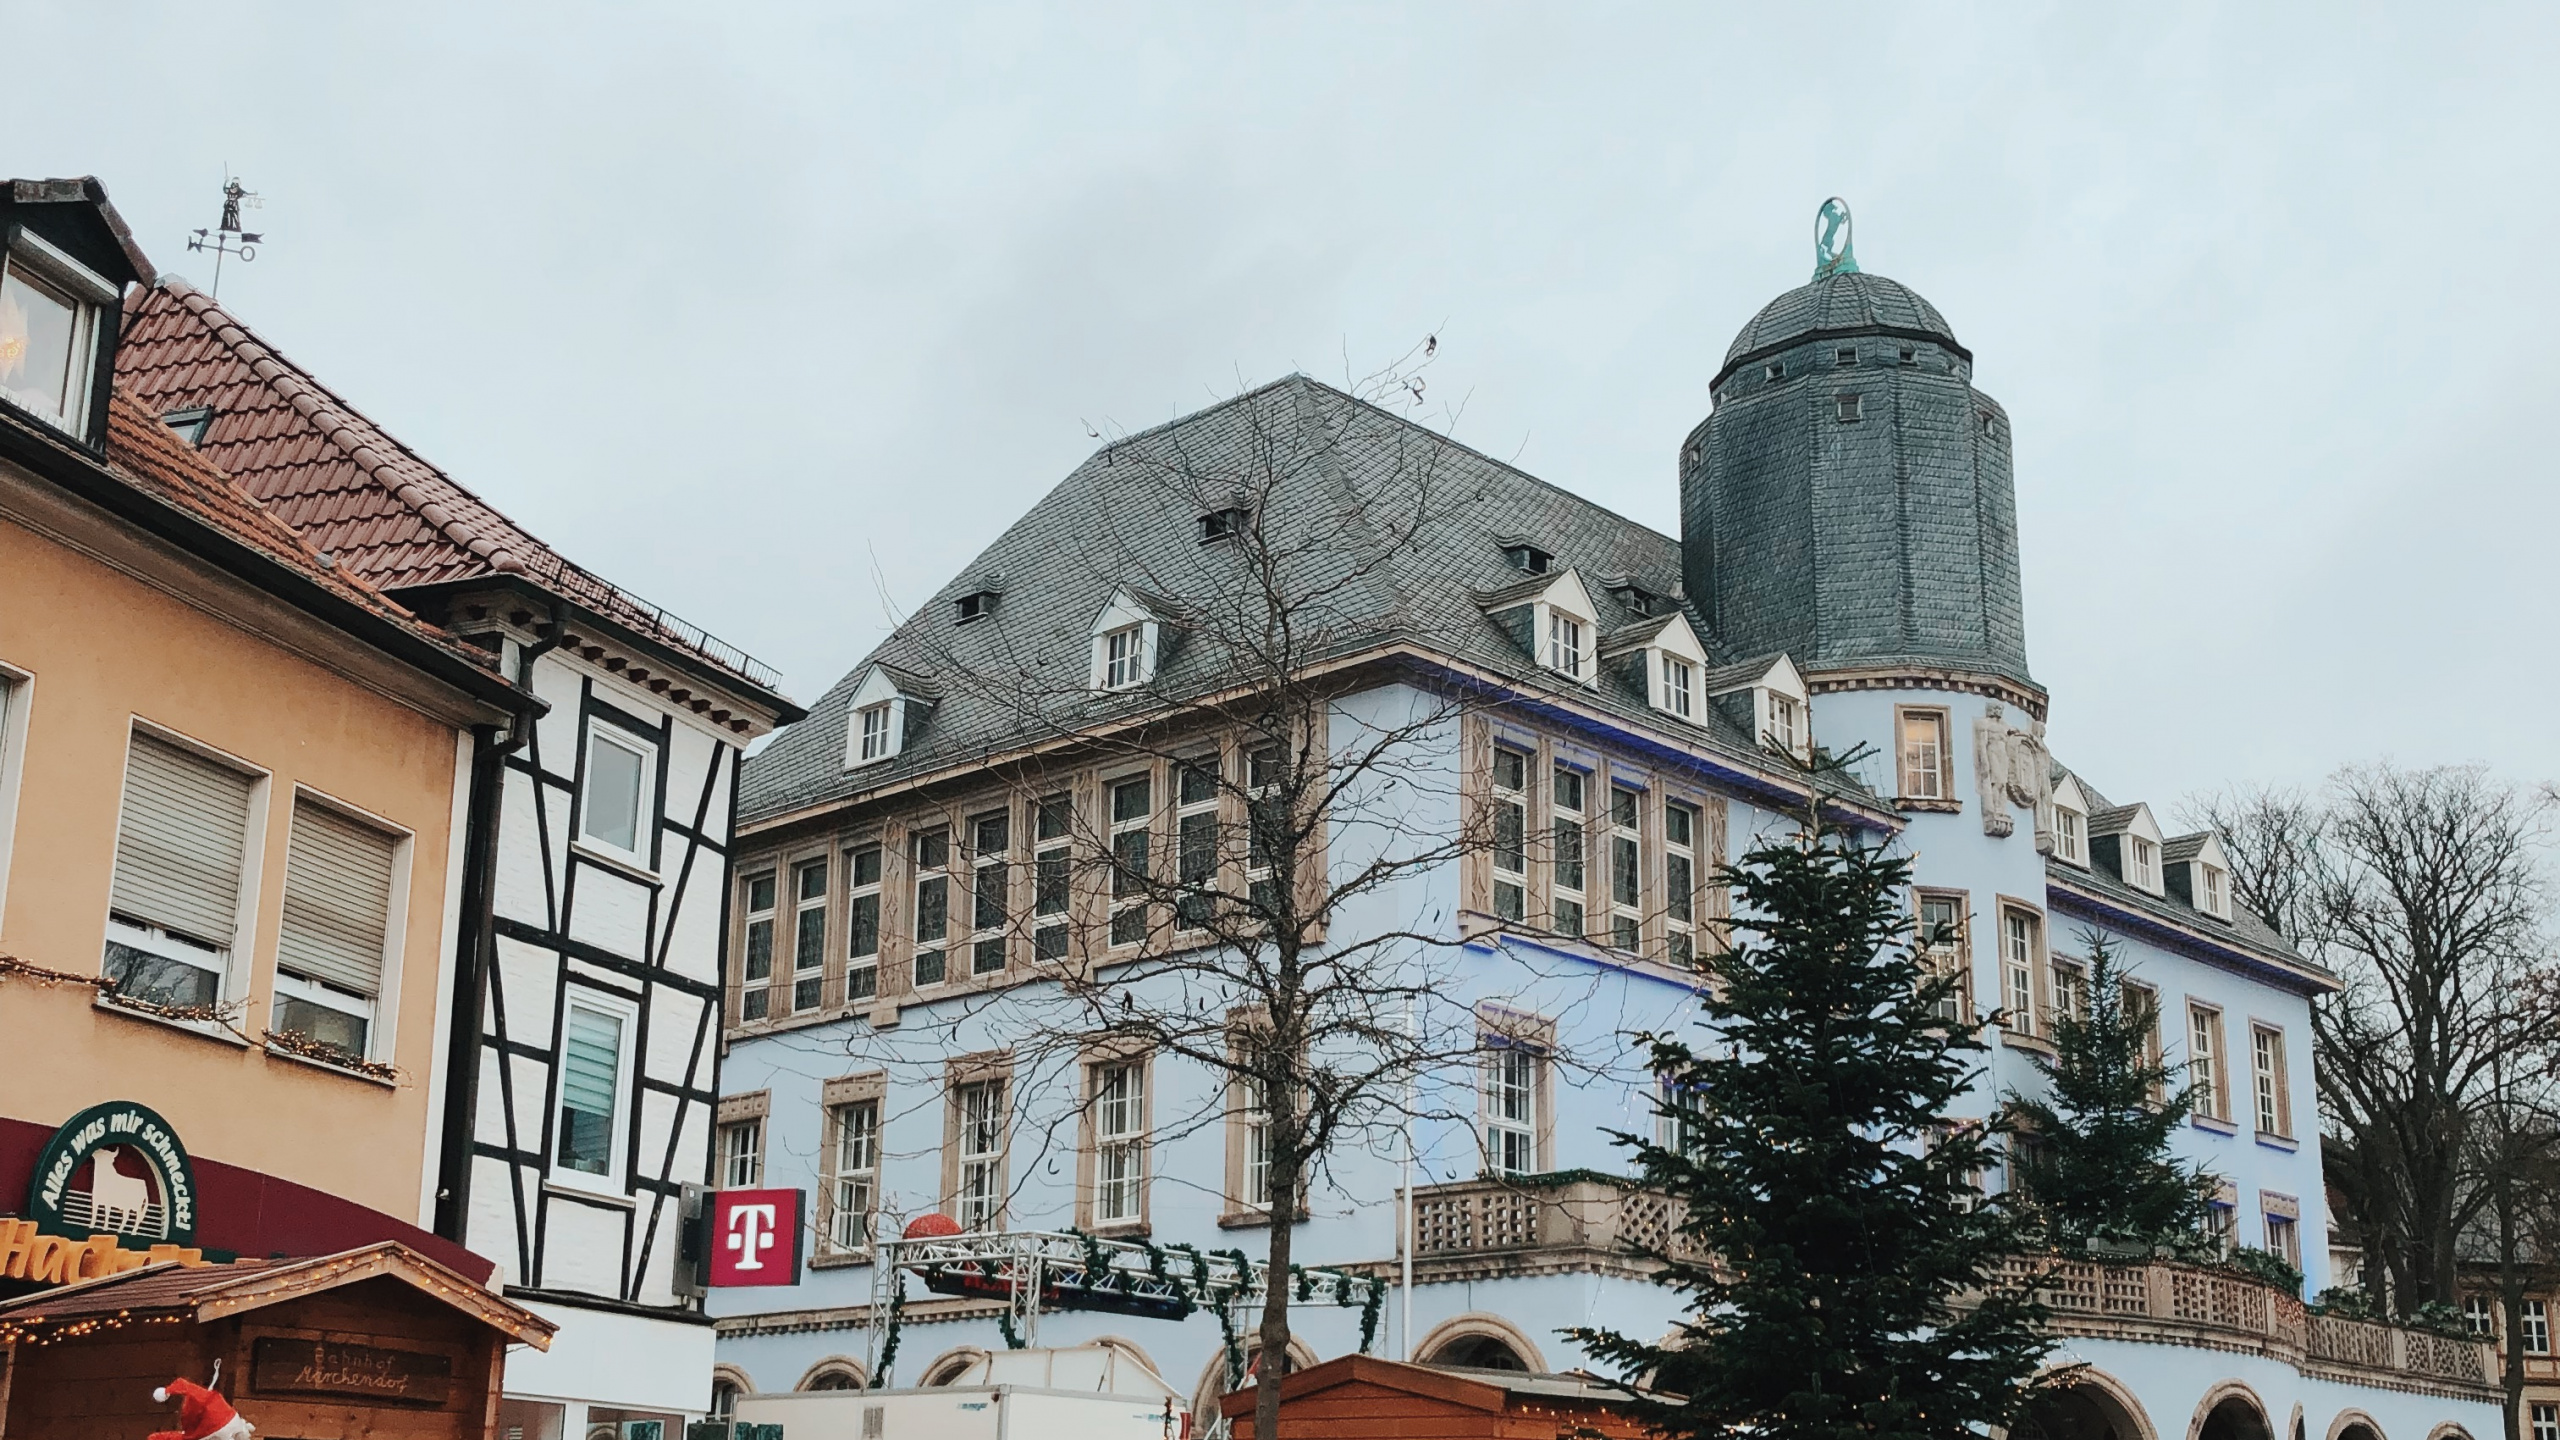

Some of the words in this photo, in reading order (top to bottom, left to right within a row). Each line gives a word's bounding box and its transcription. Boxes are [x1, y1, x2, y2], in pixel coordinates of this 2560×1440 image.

[42, 1150, 74, 1211] Alles
[71, 1116, 106, 1155] was
[110, 1109, 145, 1133] mir
[142, 1123, 192, 1231] schmeckt!
[727, 1204, 776, 1270] T
